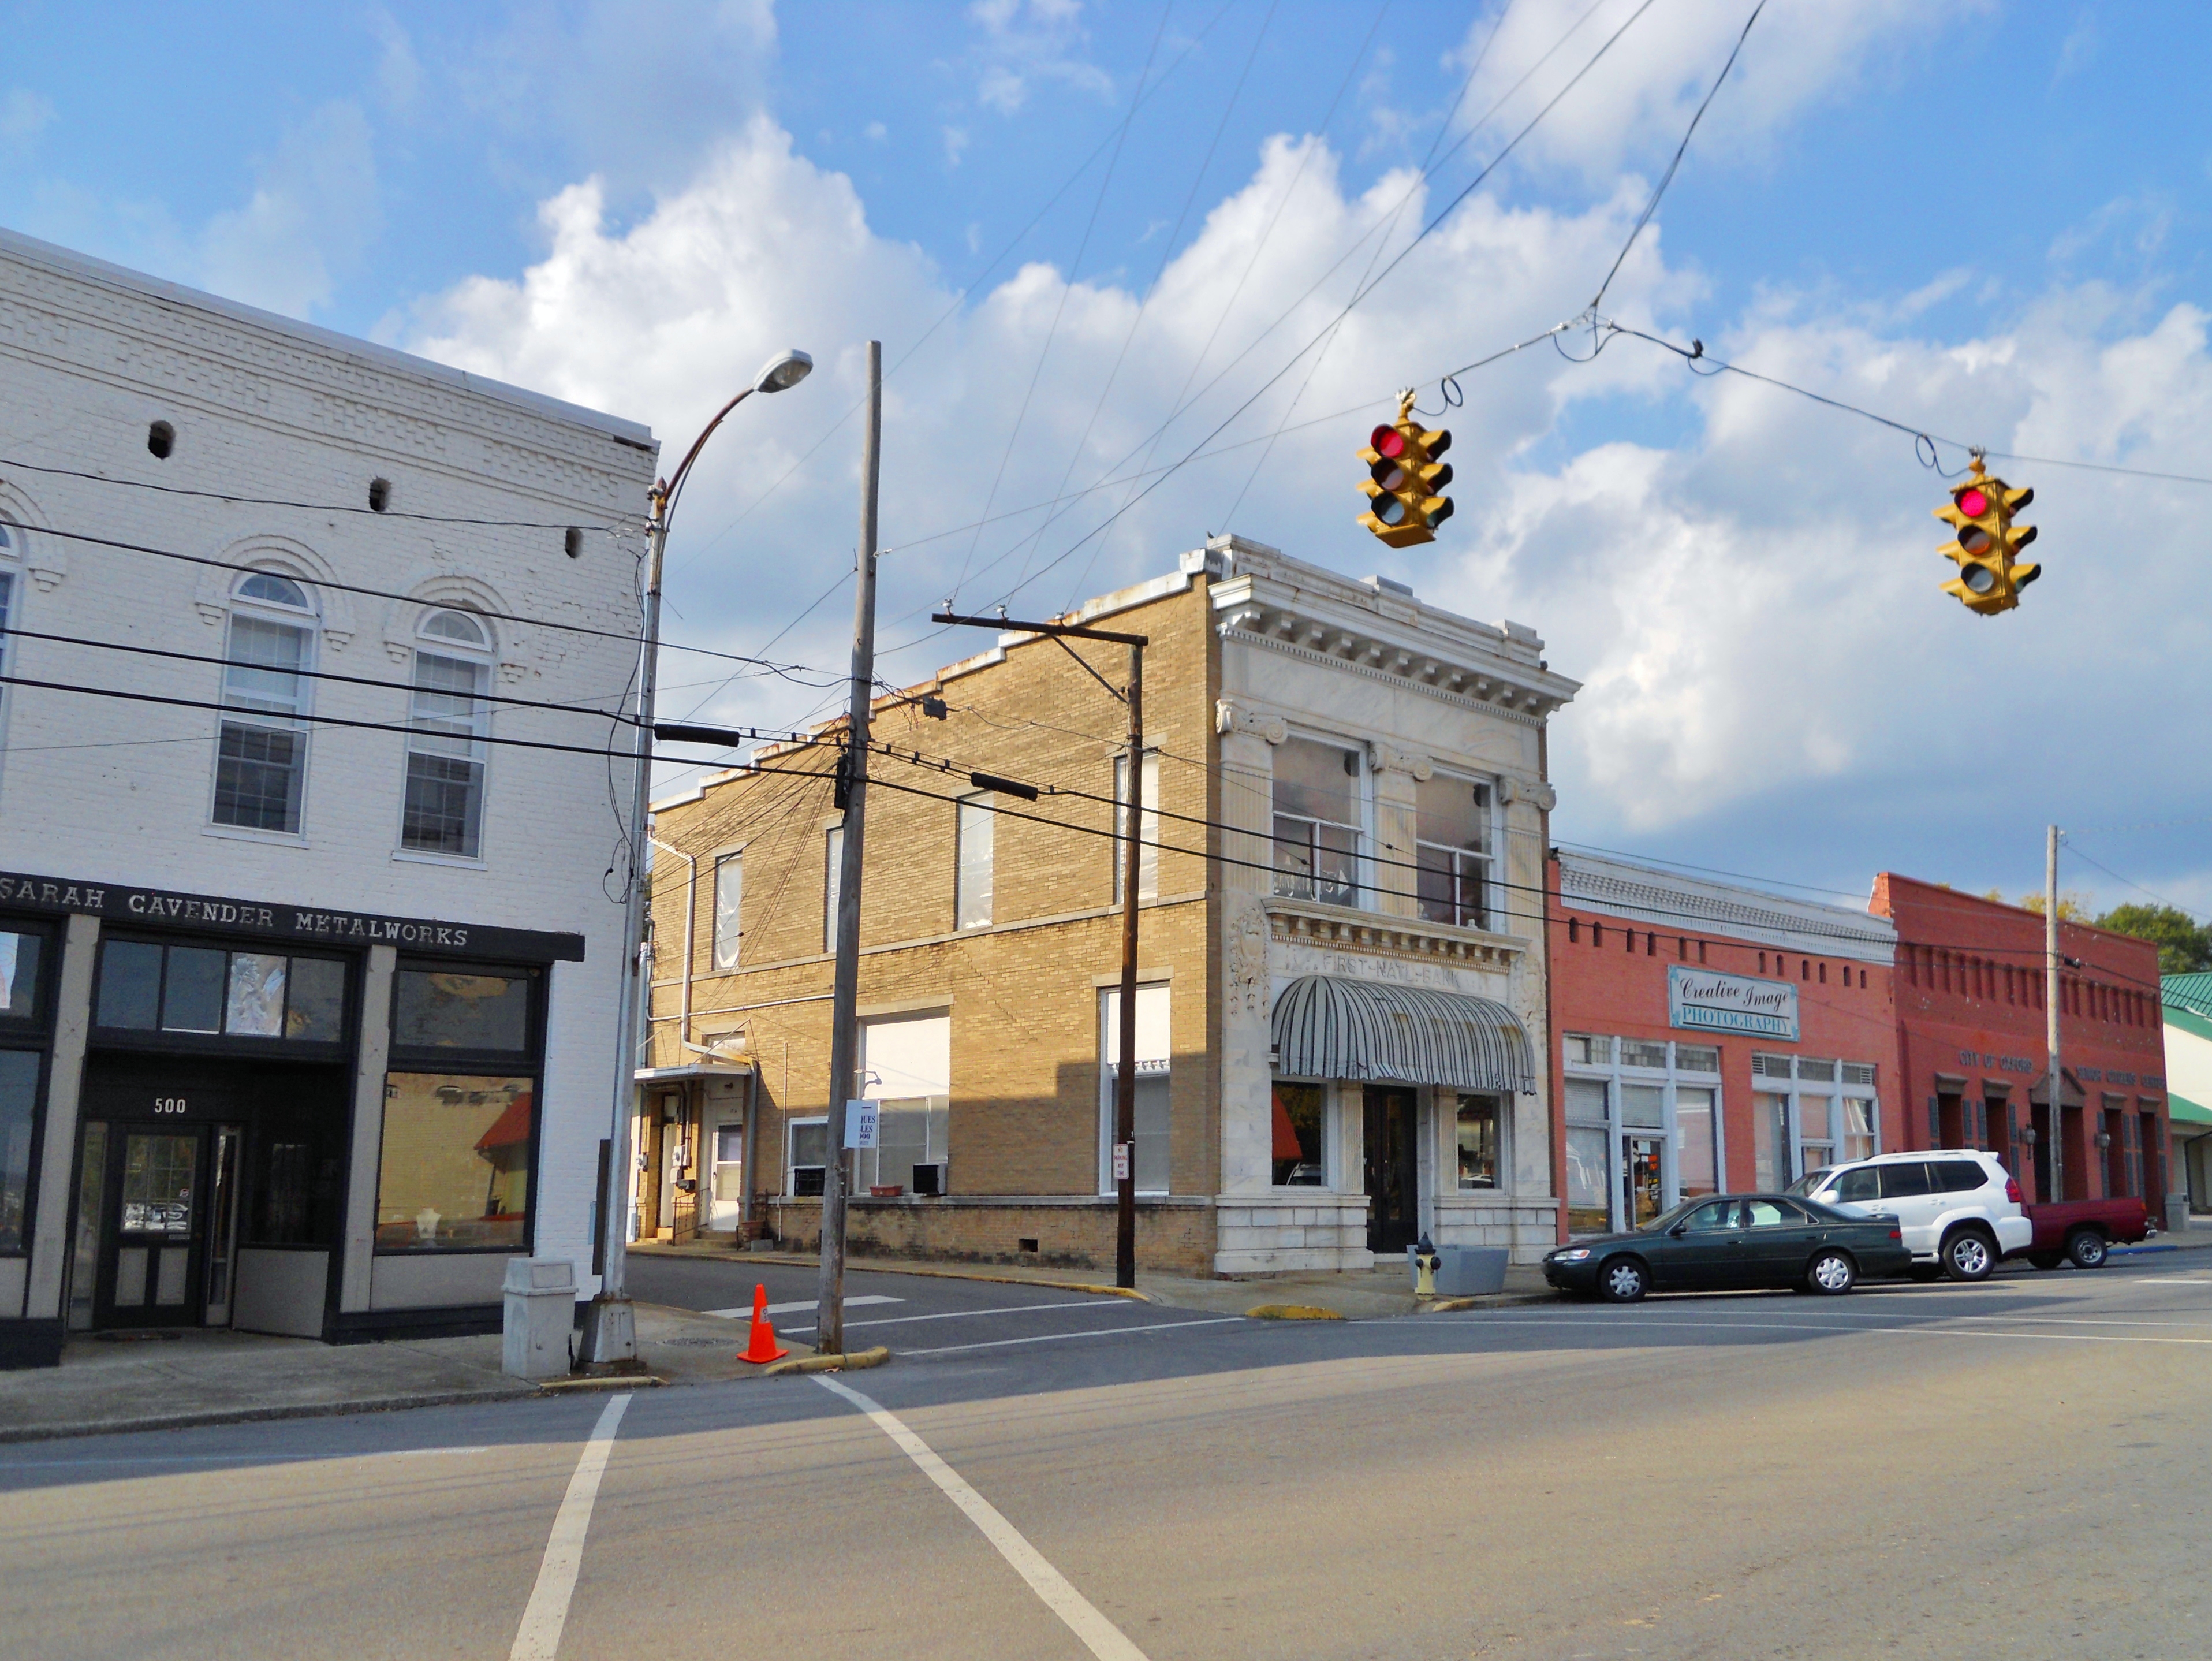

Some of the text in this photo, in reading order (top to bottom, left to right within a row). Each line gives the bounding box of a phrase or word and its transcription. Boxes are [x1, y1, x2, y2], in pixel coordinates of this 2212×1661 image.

[0, 877, 468, 946] SARAH CAVENDER METALWORKS
[1680, 977, 1789, 1012] Creative Image
[1682, 1006, 1789, 1034] PHOTOGRAPHY
[1959, 1050, 1979, 1067] CITY
[1983, 1054, 1995, 1069] OF
[2000, 1056, 2032, 1074] OXFORD
[154, 1098, 186, 1113] 500
